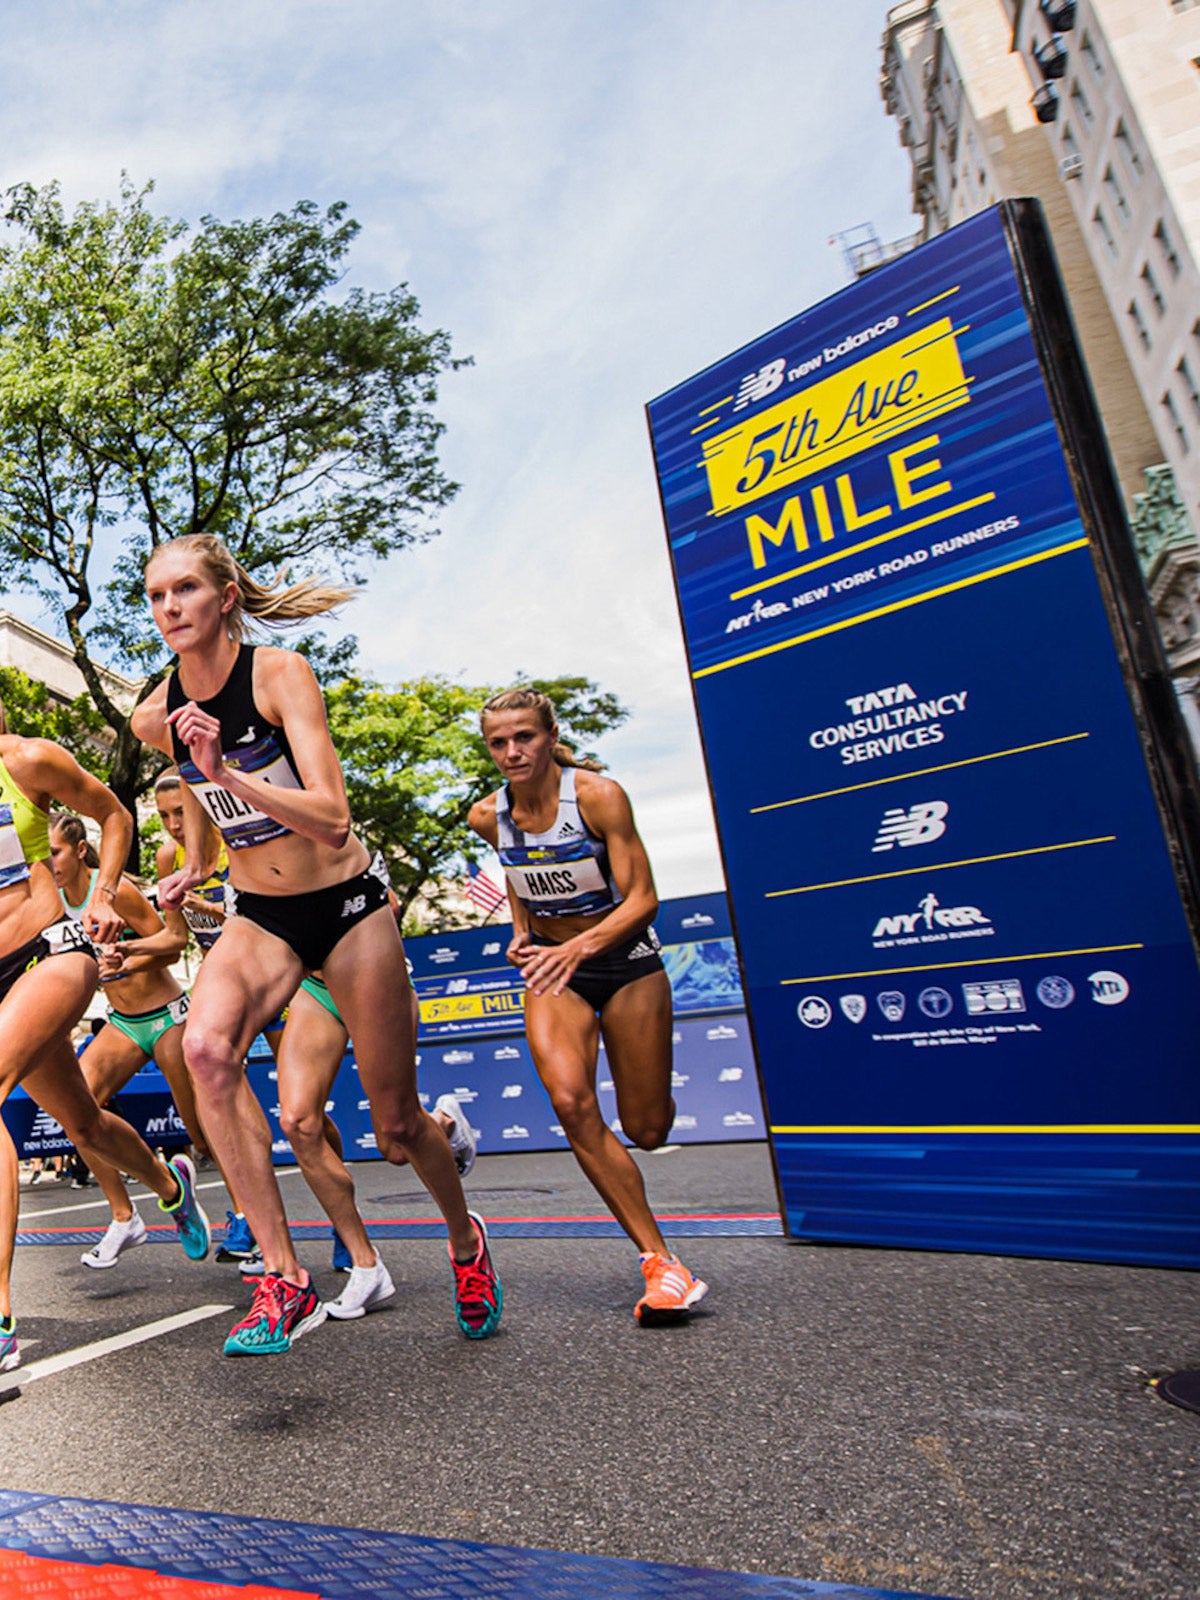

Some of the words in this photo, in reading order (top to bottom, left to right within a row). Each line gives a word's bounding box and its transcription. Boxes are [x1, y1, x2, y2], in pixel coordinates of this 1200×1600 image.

[787, 355, 823, 382] new
[823, 316, 899, 362] balance
[736, 408, 819, 493] 5th
[824, 370, 924, 442] Ave.
[745, 434, 952, 570] MILE
[792, 586, 829, 608] NEW
[831, 567, 877, 592] YORK
[879, 549, 929, 577] ROAD
[931, 515, 1021, 557] RUNNERS
[809, 691, 968, 749] CONSULTANCY
[845, 683, 917, 715] TATA
[840, 723, 945, 765] SERVICES
[205, 788, 254, 821] FUL
[524, 870, 577, 896] HAISS
[23, 1140, 41, 1151] new
